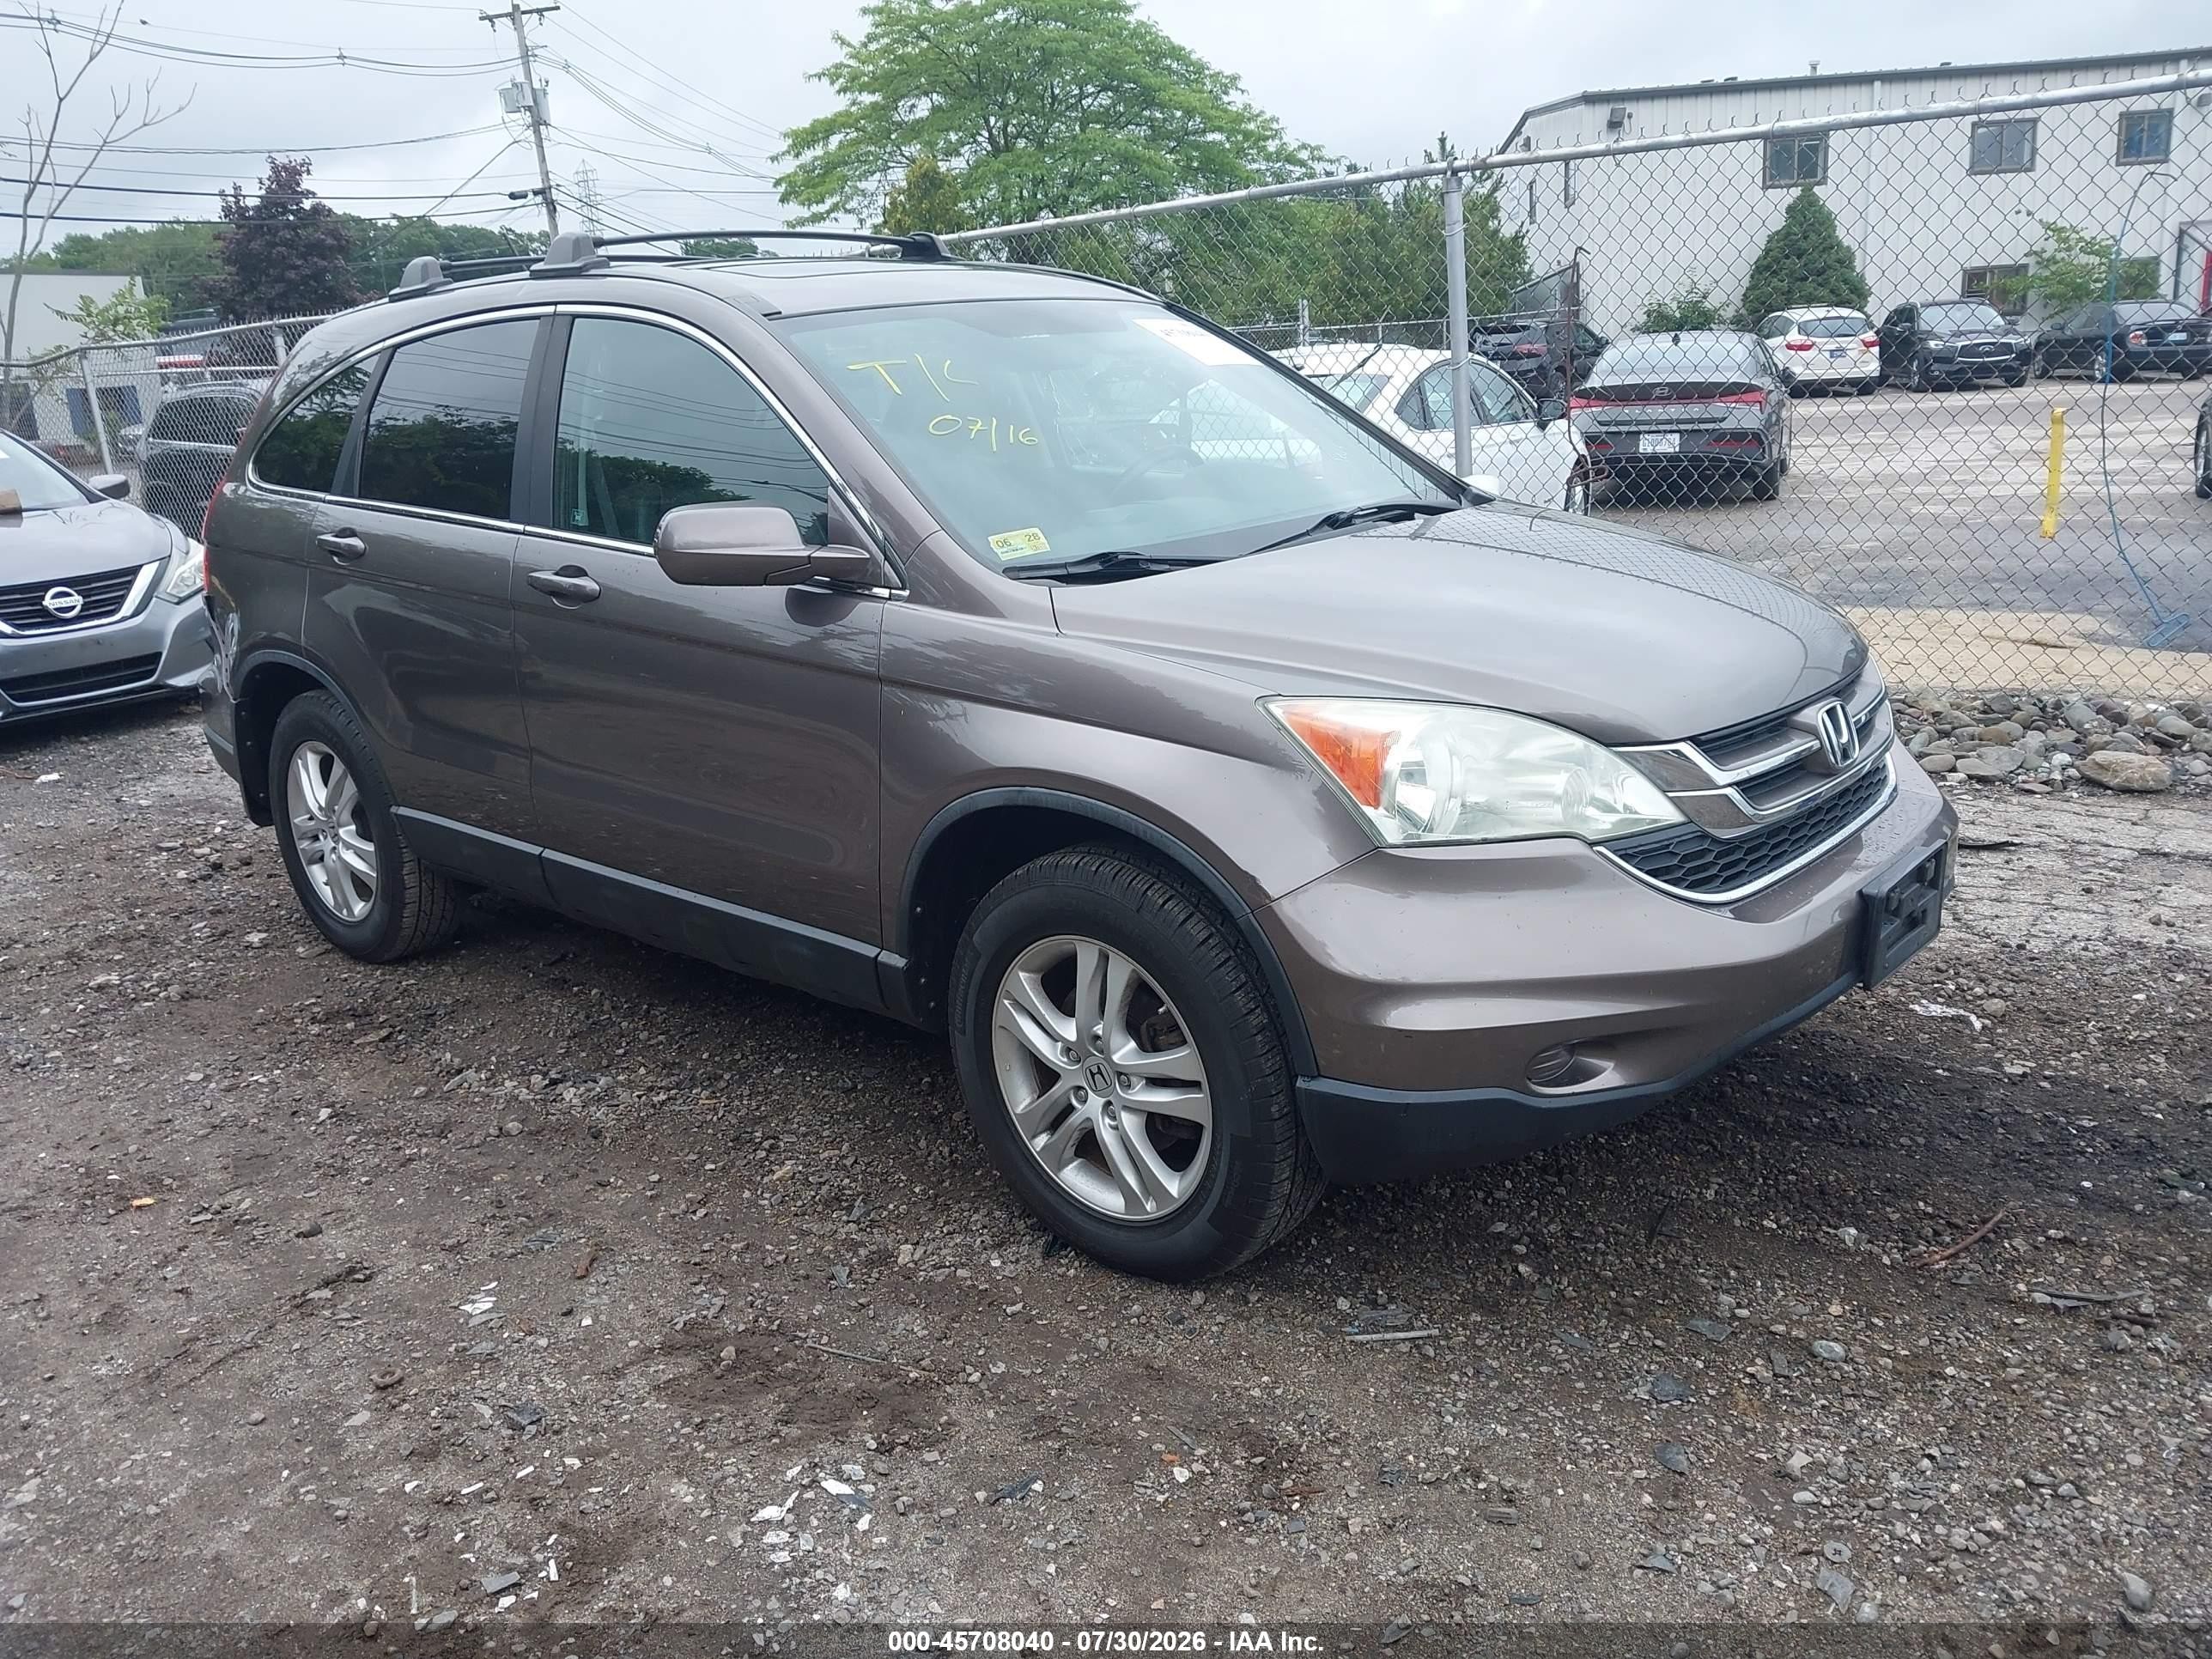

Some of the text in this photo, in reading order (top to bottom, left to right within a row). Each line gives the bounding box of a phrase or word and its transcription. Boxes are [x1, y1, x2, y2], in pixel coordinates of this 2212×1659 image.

[928, 415, 1038, 453] 07/16
[995, 532, 1041, 548] 06 28
